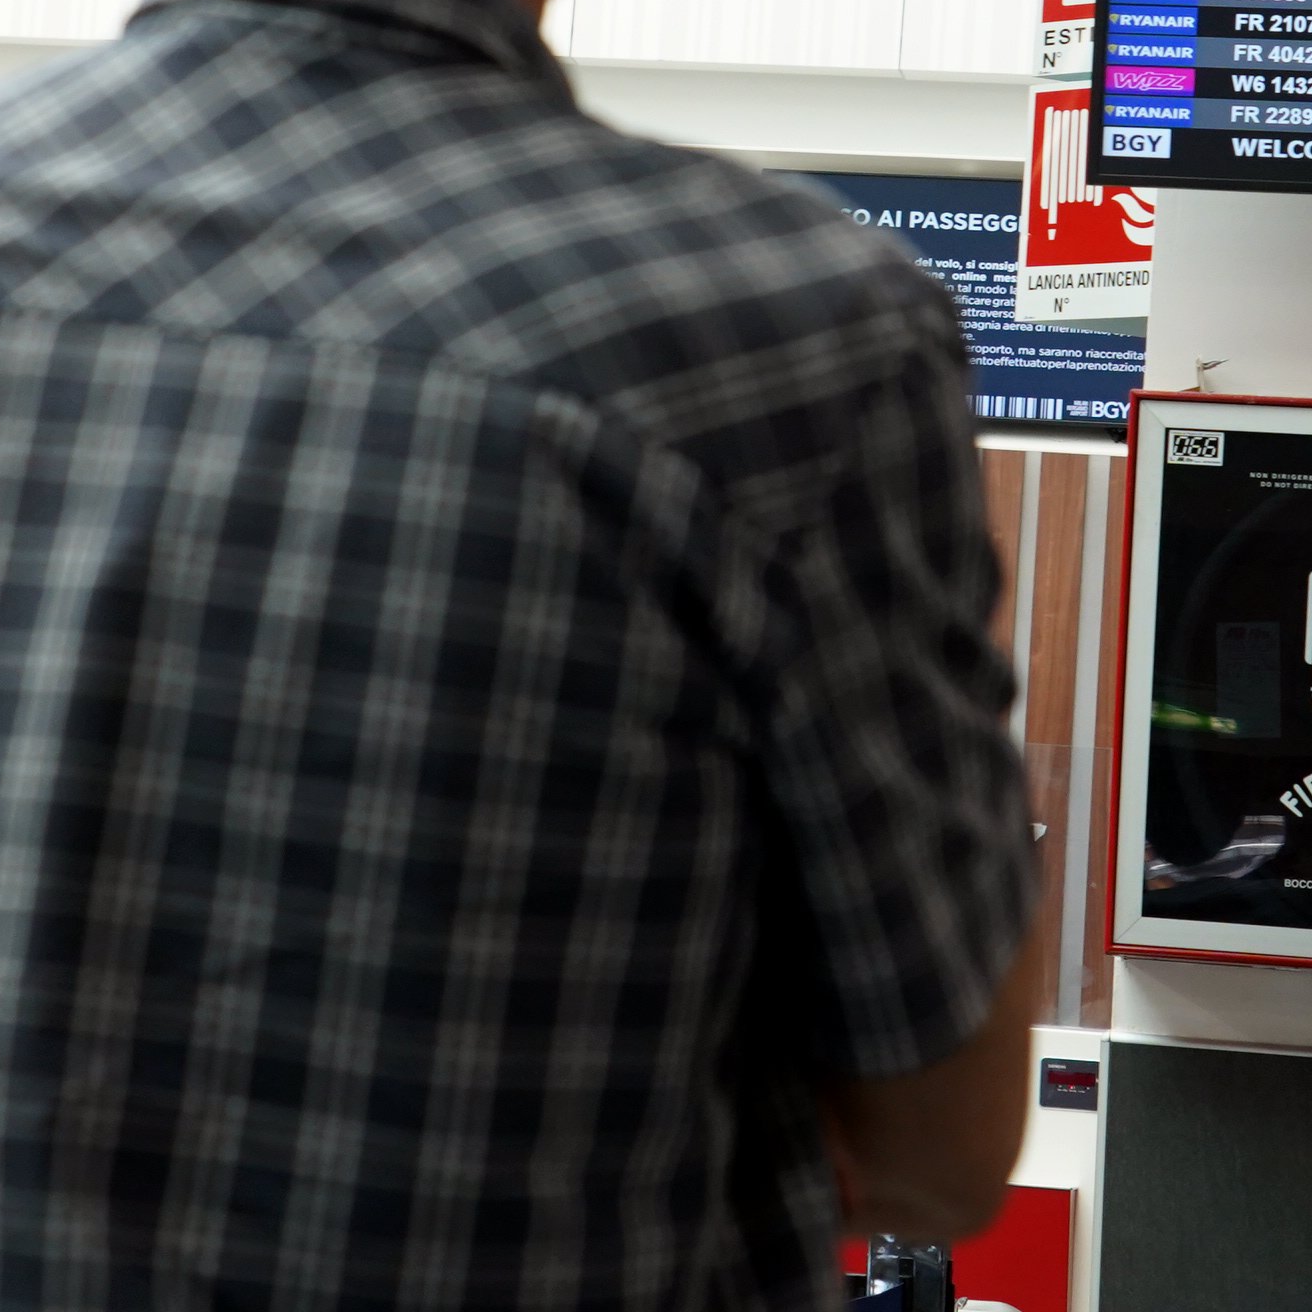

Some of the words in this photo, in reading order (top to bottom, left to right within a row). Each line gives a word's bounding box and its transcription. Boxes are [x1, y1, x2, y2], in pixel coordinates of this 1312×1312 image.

[1232, 75, 1265, 92] W6
[1111, 130, 1162, 156] BGY
[877, 211, 902, 227] AI
[1028, 274, 1073, 290] LANCIA
[1173, 436, 1218, 458] 066
